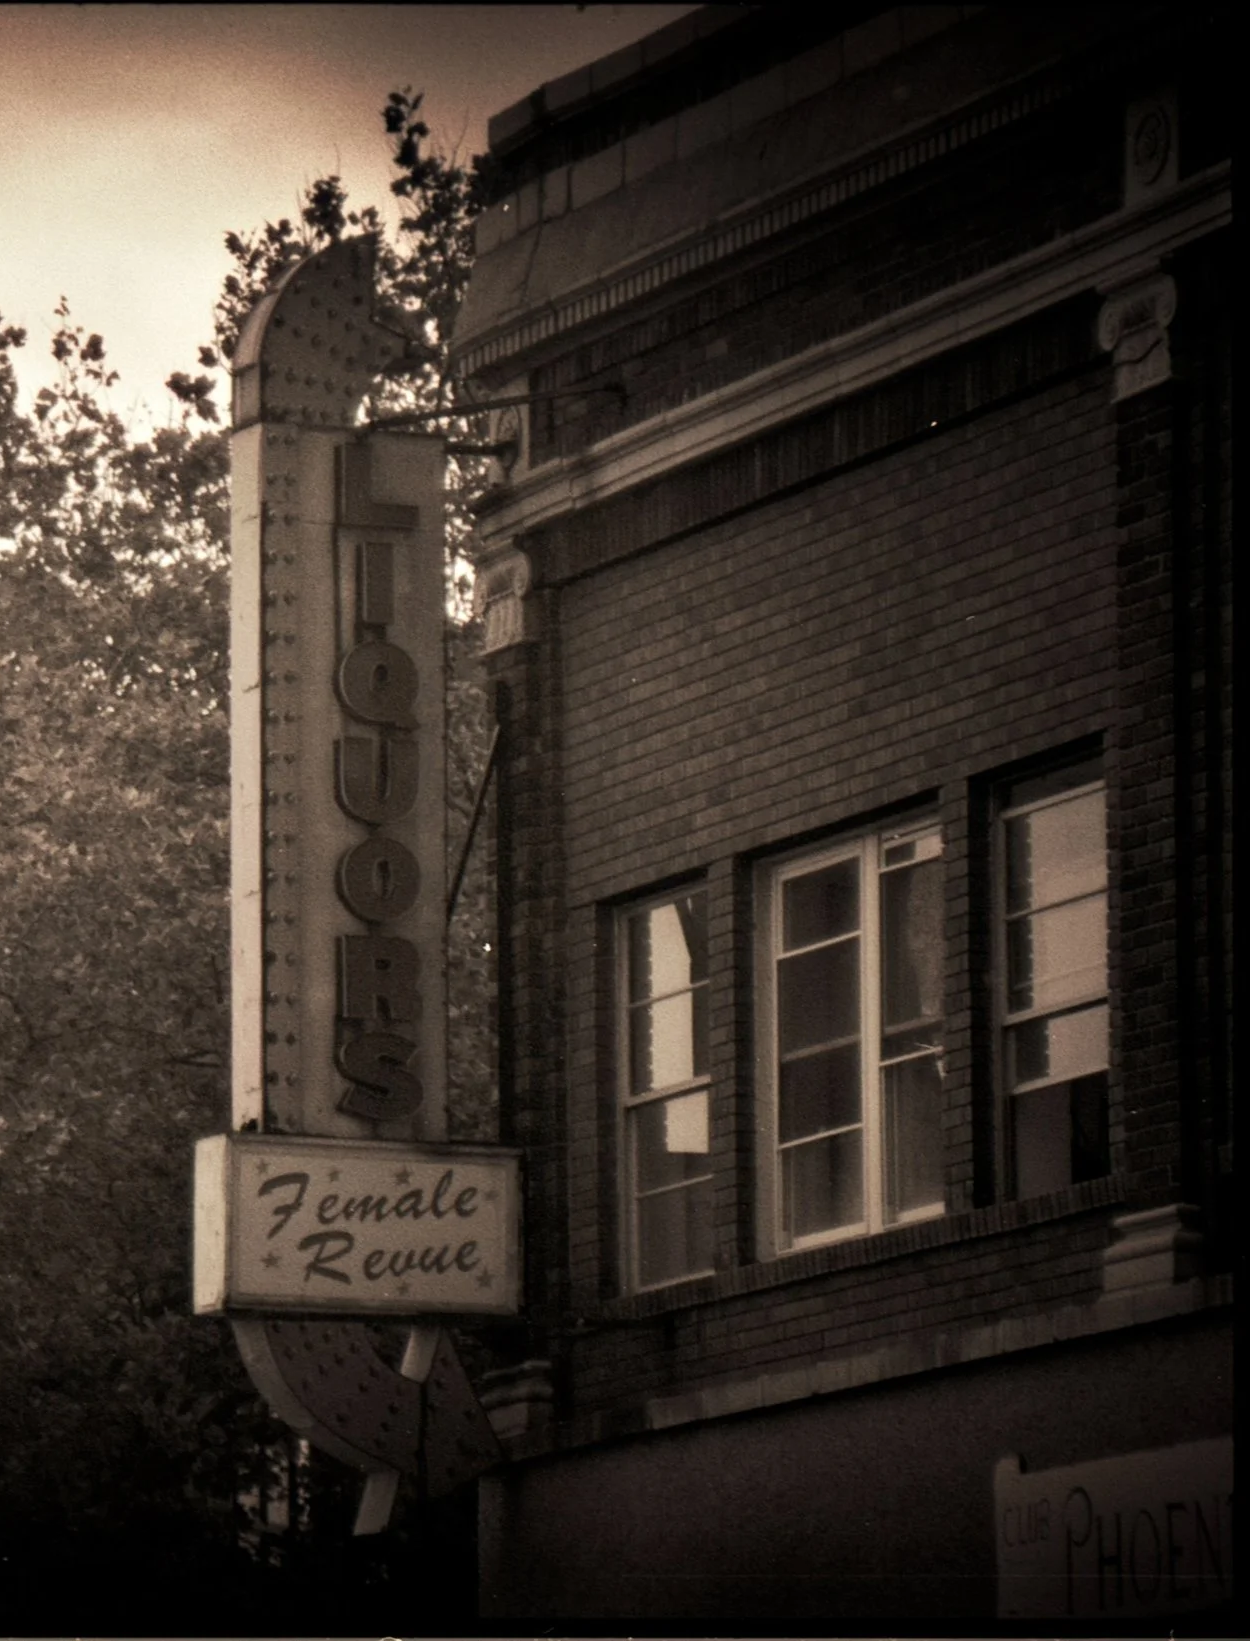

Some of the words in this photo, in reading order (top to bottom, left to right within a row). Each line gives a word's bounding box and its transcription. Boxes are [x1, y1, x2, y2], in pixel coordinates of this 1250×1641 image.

[333, 441, 423, 1120] LIQUORS
[258, 1169, 478, 1239] Female
[297, 1230, 480, 1284] Revue
